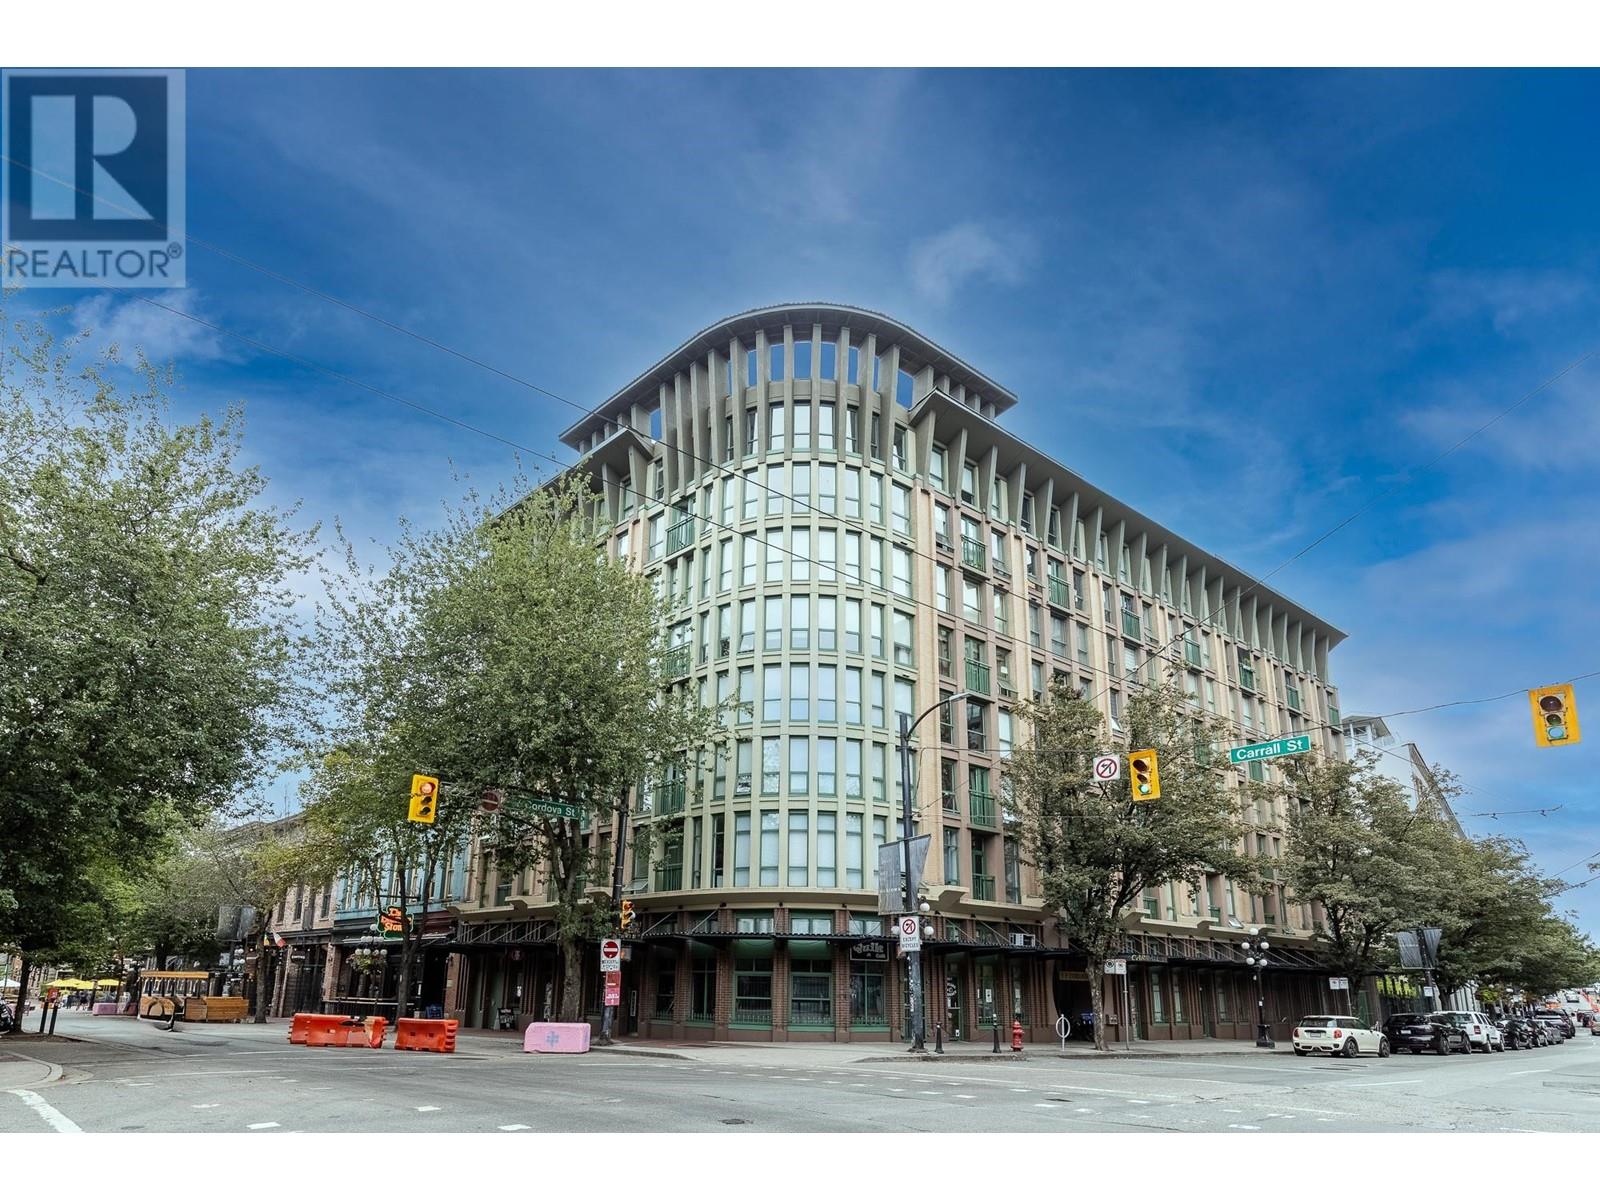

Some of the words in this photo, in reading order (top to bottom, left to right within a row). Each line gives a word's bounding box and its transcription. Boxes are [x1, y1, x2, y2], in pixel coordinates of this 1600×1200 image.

[1236, 743, 1280, 760] Carrall
[1286, 739, 1303, 752] St
[565, 806, 575, 817] St
